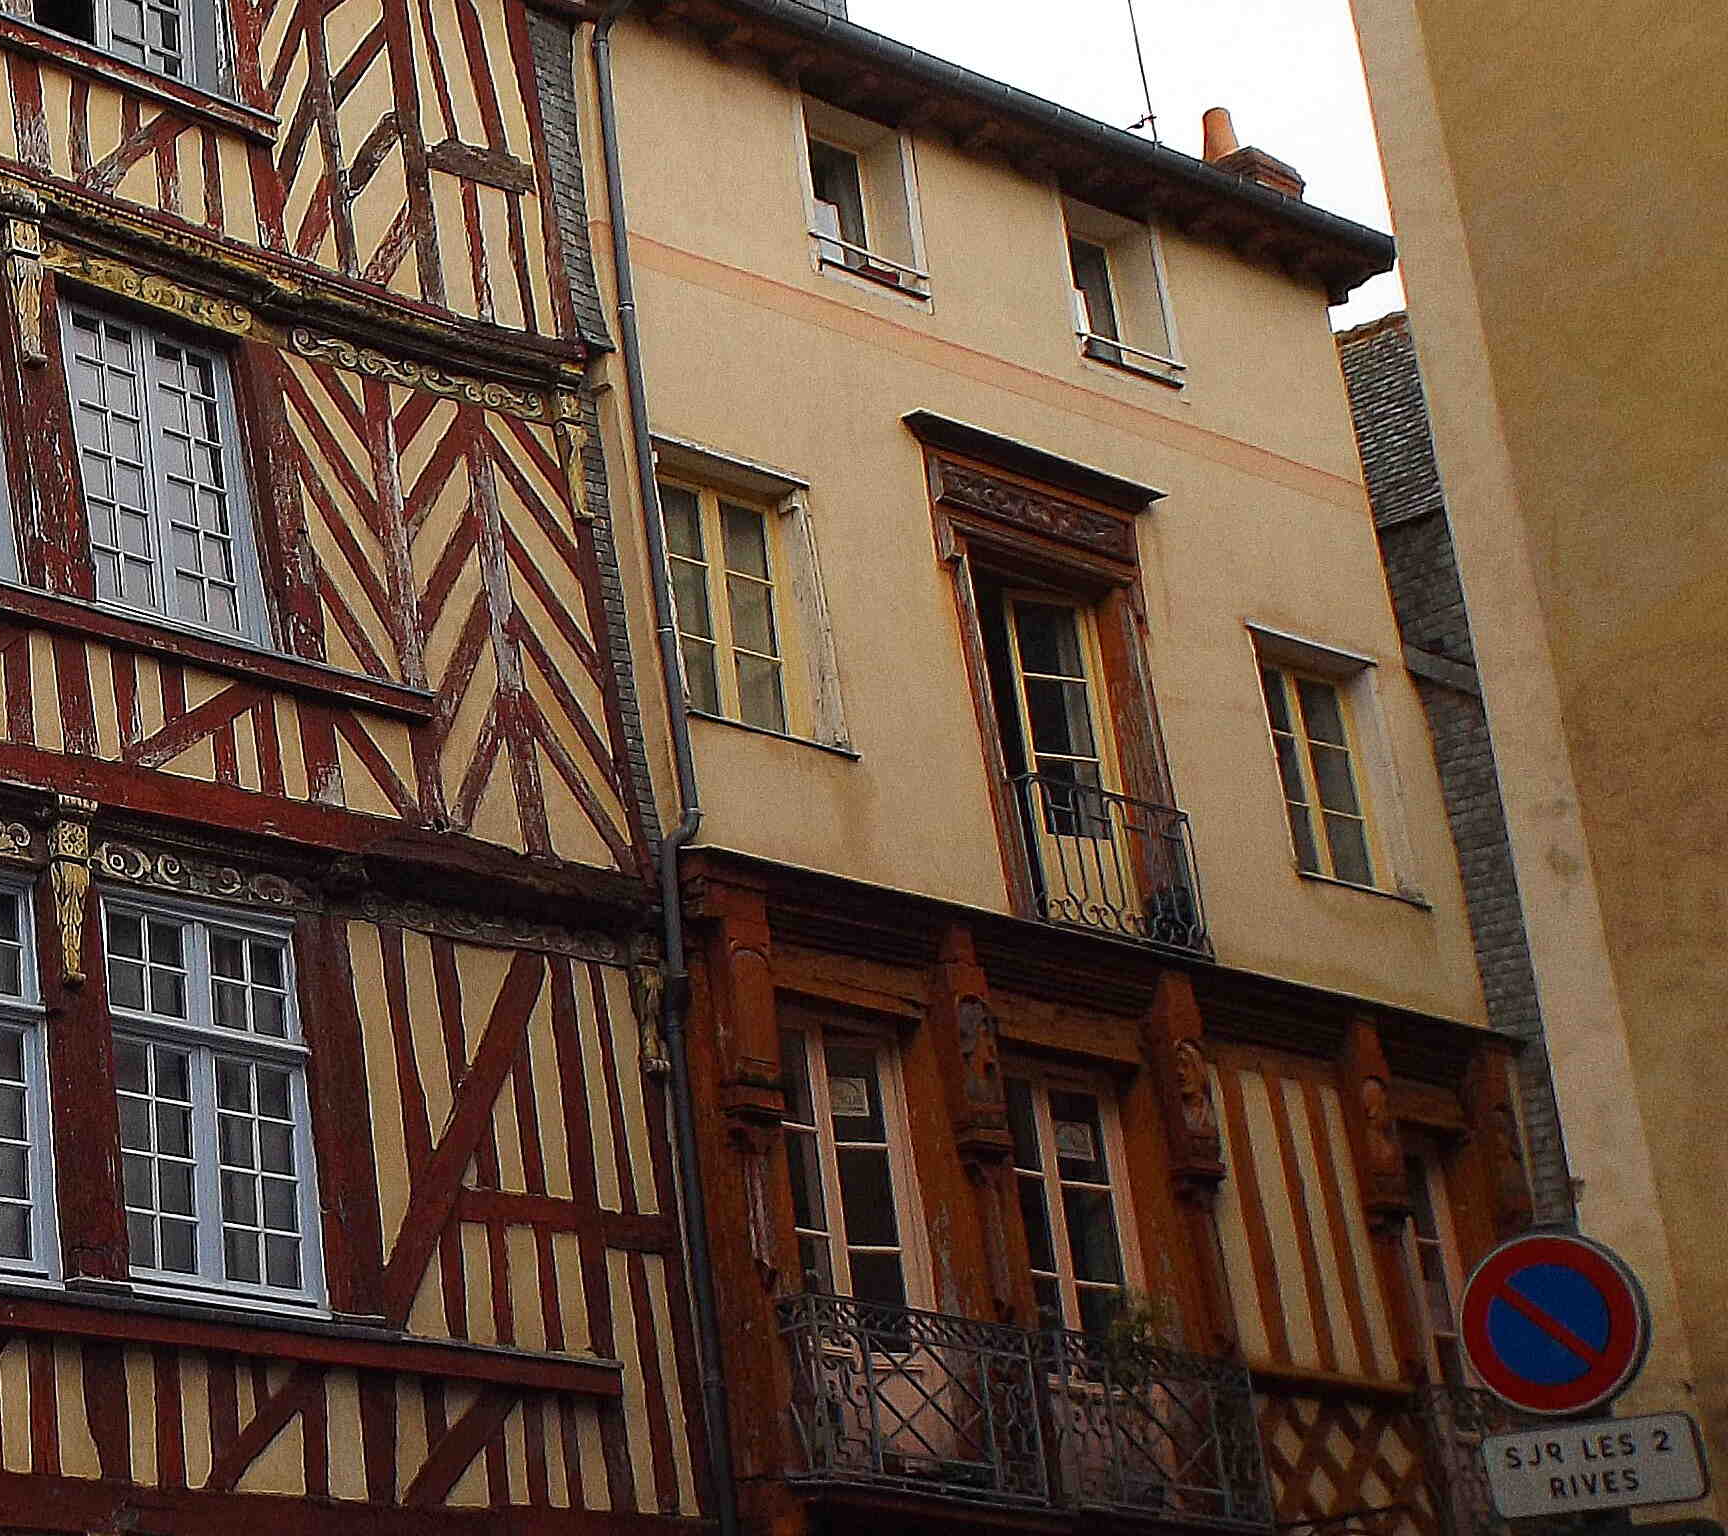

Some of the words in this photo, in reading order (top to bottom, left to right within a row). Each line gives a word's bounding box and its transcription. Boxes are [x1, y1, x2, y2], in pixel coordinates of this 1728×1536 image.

[1583, 1431, 1635, 1460] LES
[1652, 1429, 1670, 1452] 2
[1550, 1468, 1640, 1498] RIVES
